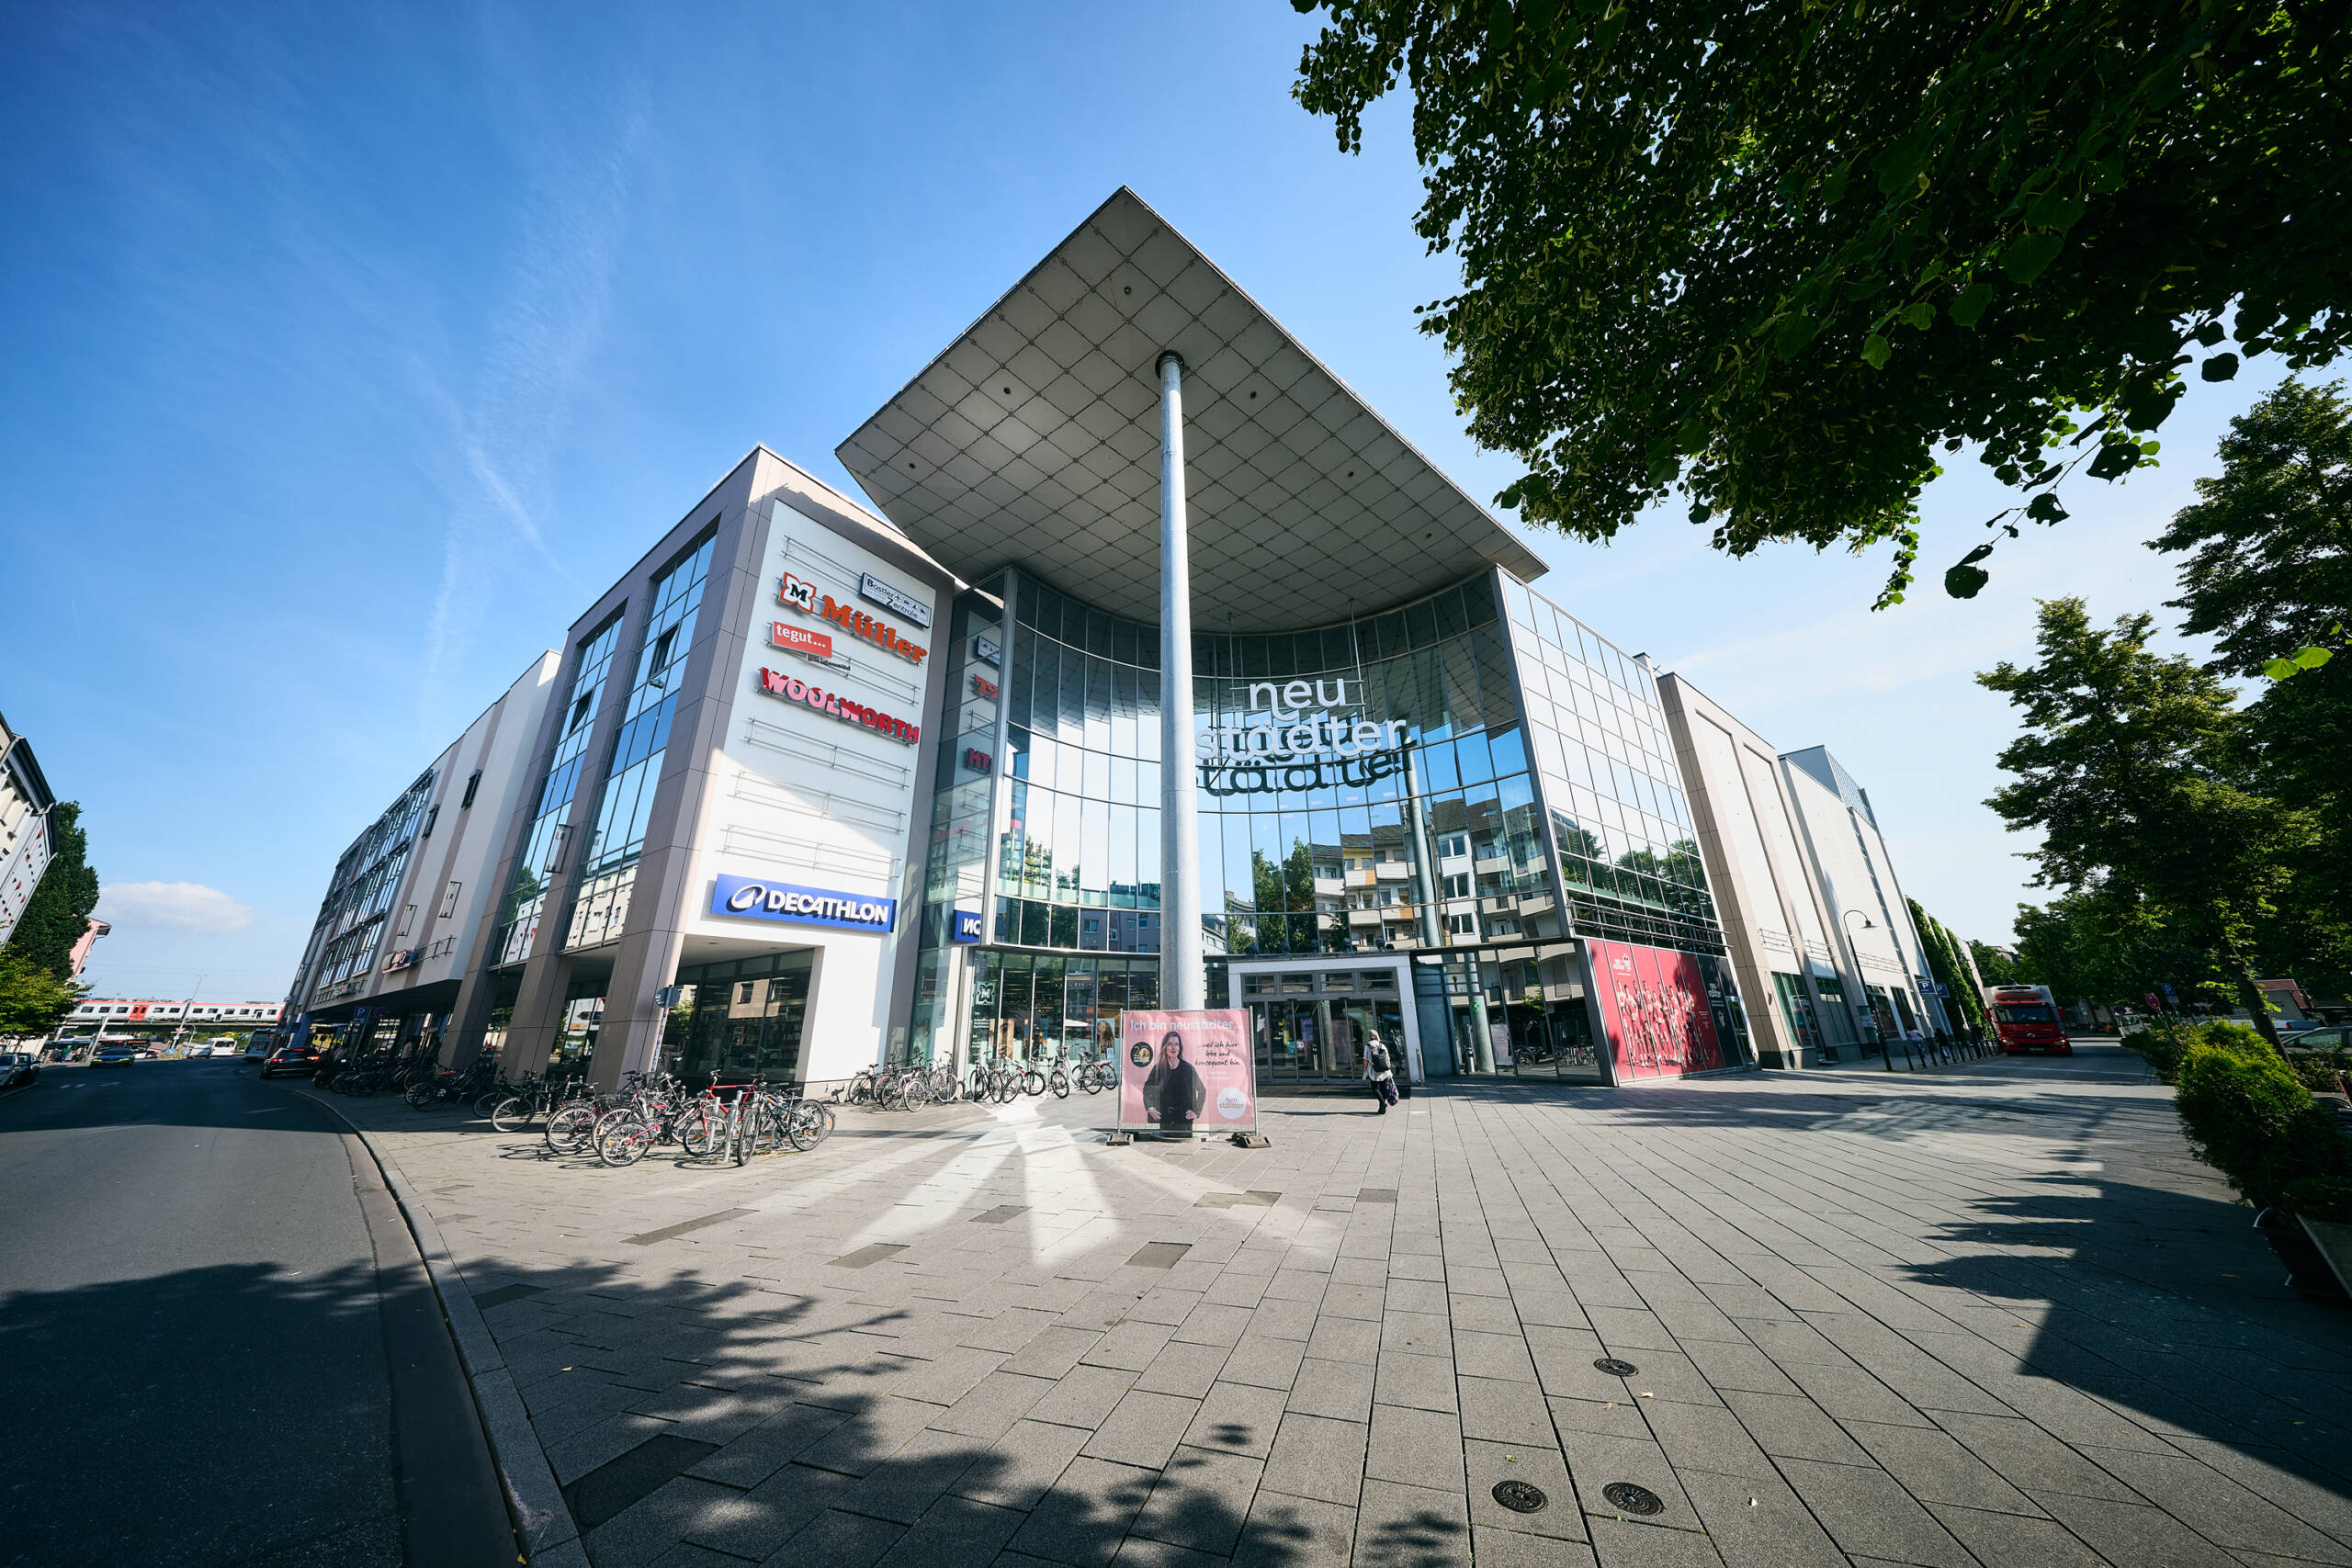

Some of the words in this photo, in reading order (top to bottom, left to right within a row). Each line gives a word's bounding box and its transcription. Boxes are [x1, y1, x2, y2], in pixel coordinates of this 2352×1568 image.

[789, 583, 808, 603] M
[776, 625, 826, 648] tegut...
[820, 594, 928, 662] Müller
[761, 666, 920, 744] WOOLWORTH
[1250, 678, 1347, 722] neu
[1195, 714, 1407, 761] städter
[768, 890, 889, 923] DECATHLON
[1130, 1020, 1147, 1031] Ich
[1148, 1019, 1168, 1031] bin
